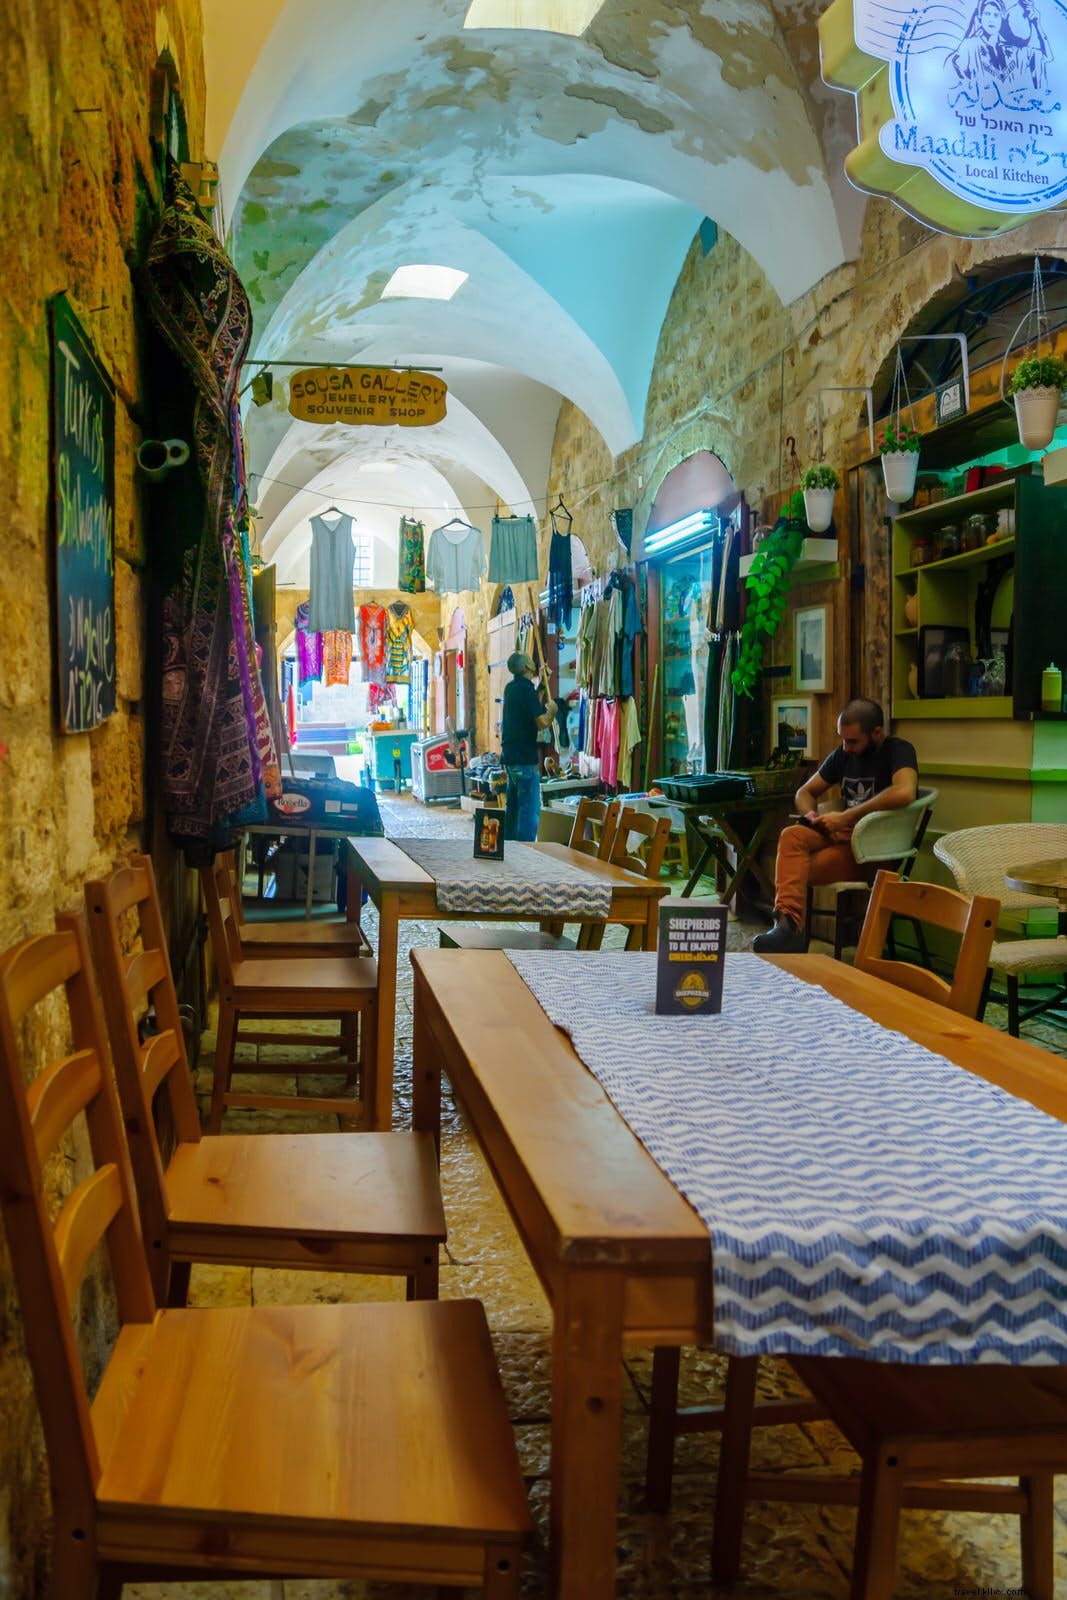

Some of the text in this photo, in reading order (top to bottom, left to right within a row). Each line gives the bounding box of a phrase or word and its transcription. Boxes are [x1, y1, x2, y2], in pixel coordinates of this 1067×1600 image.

[954, 110, 1054, 137] בית האוכל של
[894, 123, 998, 161] Maadali
[965, 164, 1050, 185] Local Kitchen
[293, 374, 445, 405] SOUSA GALLERY
[321, 392, 397, 406] JEWELERY
[307, 404, 426, 417] SOUVENIR SHOP
[669, 918, 720, 930] SHEPHERDS
[687, 932, 719, 941] AVAILABLE
[669, 942, 678, 951] TO
[691, 942, 719, 951] ENJOYED
